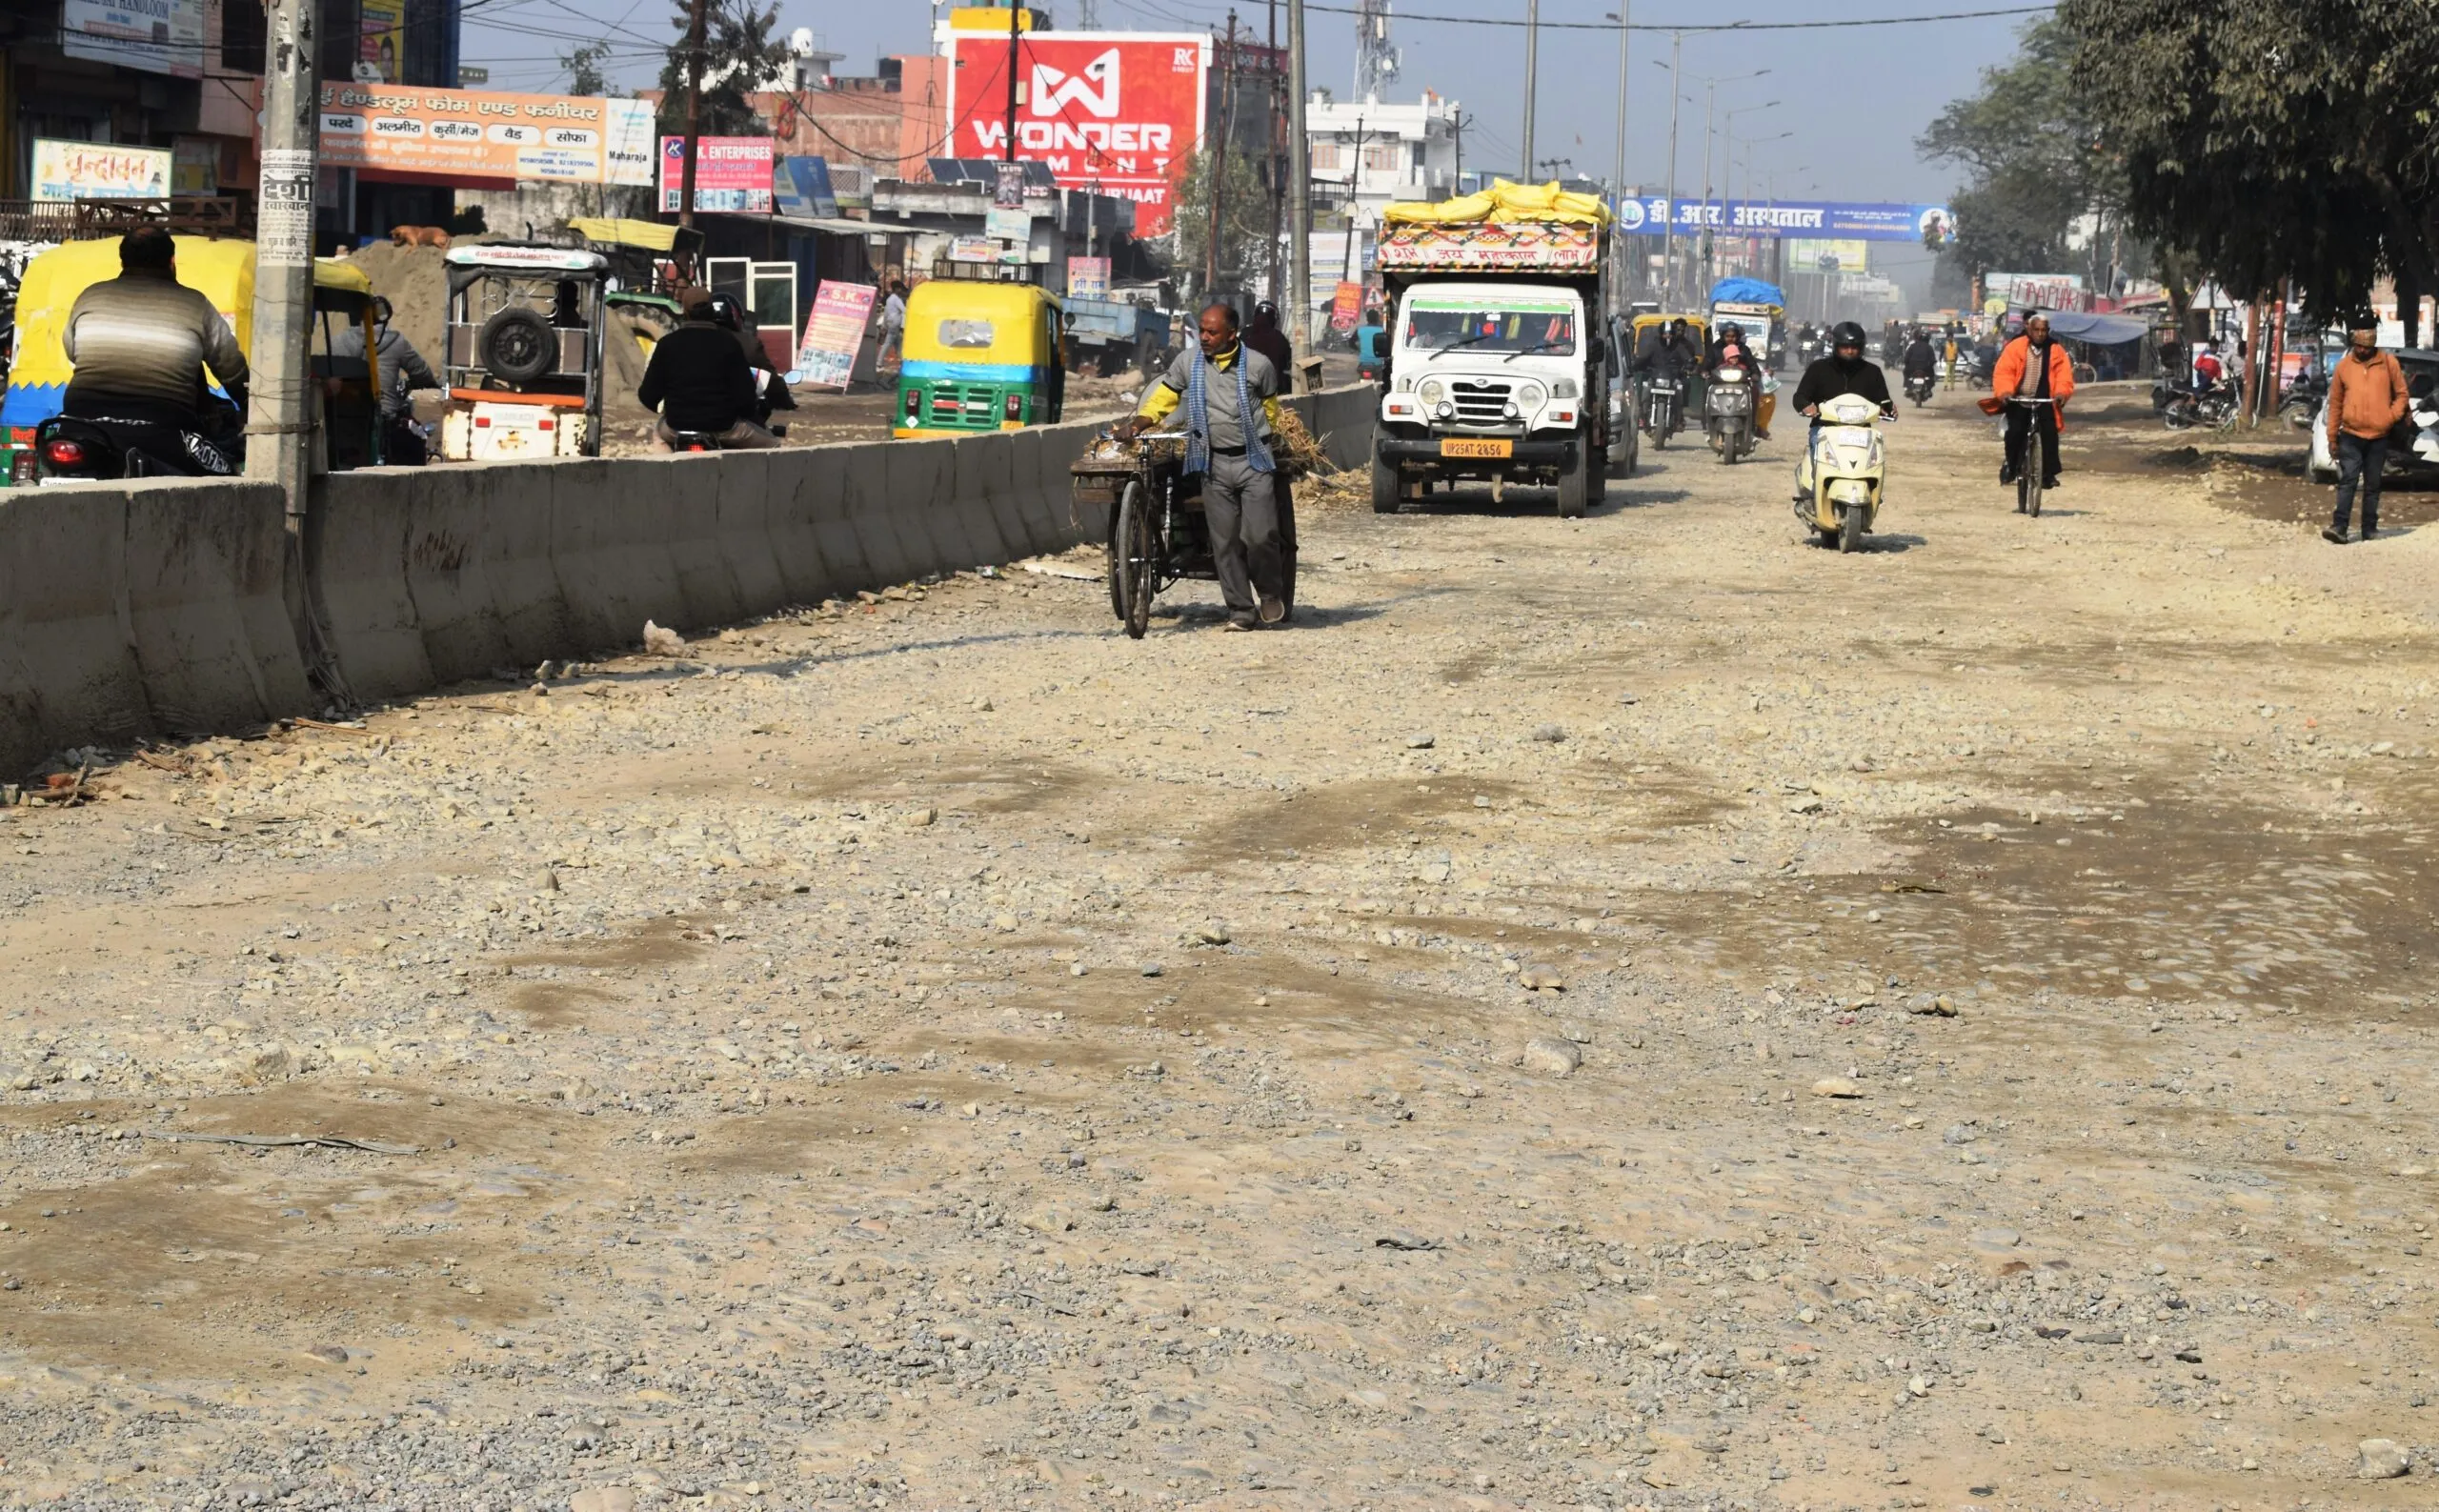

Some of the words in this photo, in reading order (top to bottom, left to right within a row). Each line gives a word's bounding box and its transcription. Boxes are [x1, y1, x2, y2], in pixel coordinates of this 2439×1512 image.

[425, 96, 471, 112] फोम
[477, 101, 517, 117] एण्ड
[328, 117, 353, 130] परदे
[375, 121, 421, 133] अलमीरा
[556, 131, 587, 143] सोफा
[972, 120, 1171, 151] WONDER
[609, 151, 647, 163] Maharaja
[709, 145, 771, 160] ENTERPRISES
[1733, 206, 1824, 228] अस्पताल
[1436, 249, 1464, 260] जय
